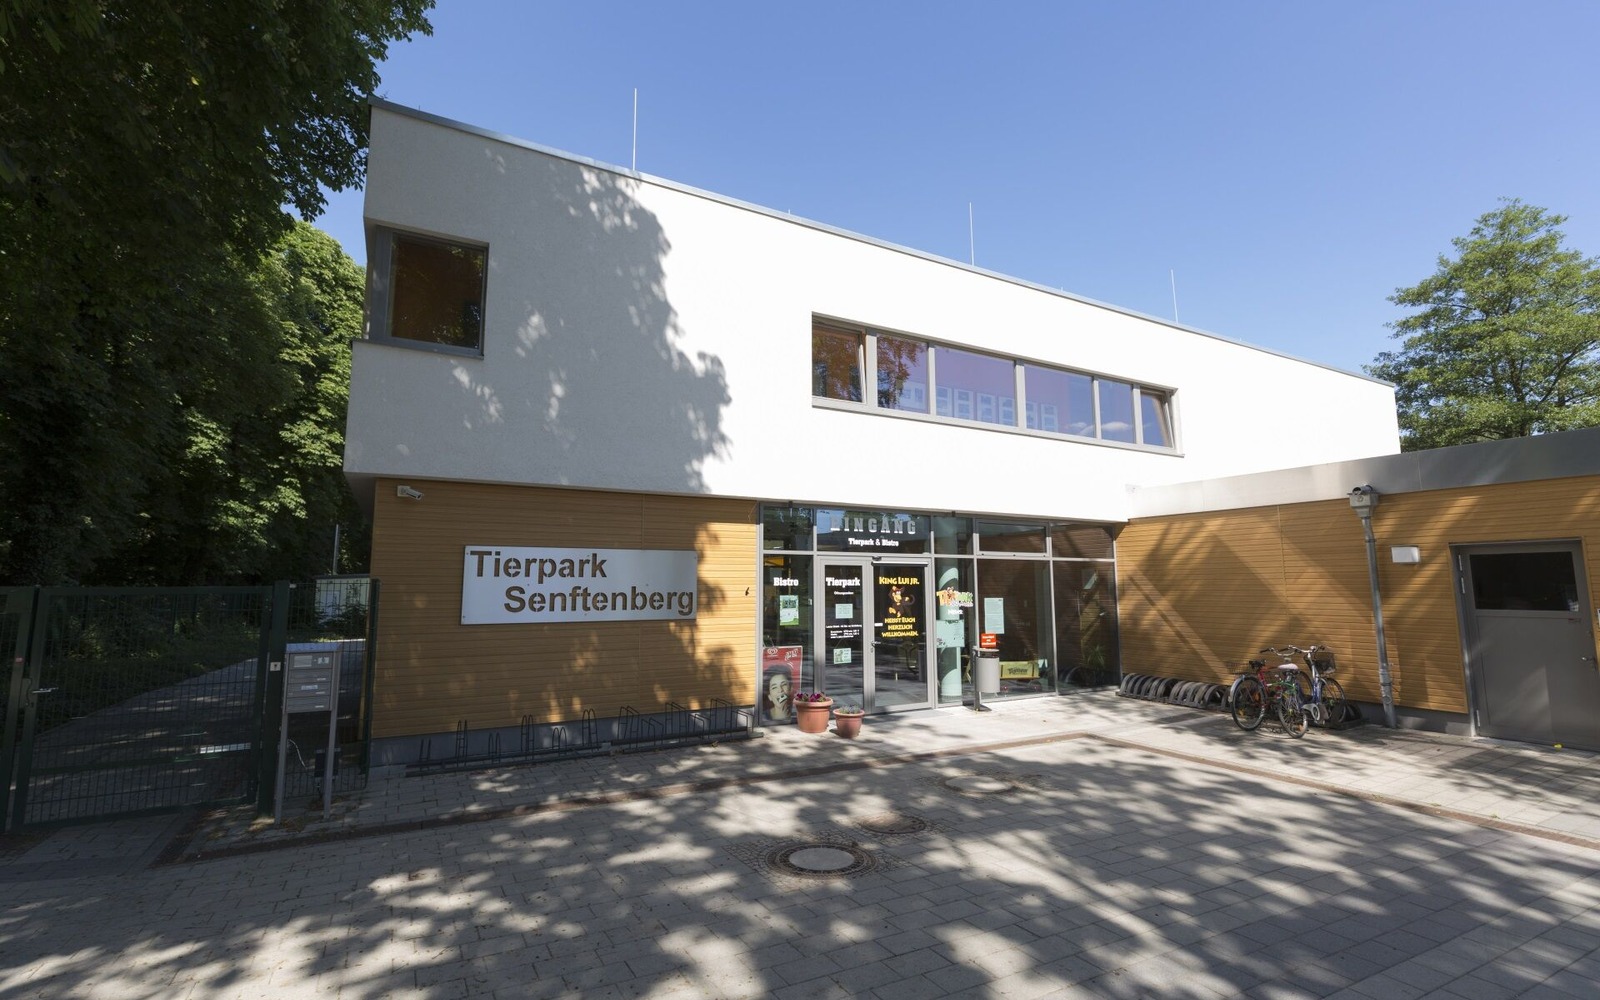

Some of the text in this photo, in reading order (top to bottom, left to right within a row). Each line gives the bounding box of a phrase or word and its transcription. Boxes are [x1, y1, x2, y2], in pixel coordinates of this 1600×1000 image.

[848, 537, 874, 547] Tierpark
[881, 539, 899, 547] Bistro
[470, 550, 607, 584] Tierpark
[773, 577, 799, 587] Bistro
[825, 577, 861, 589] Tierpark
[504, 586, 694, 616] Senftenberg
